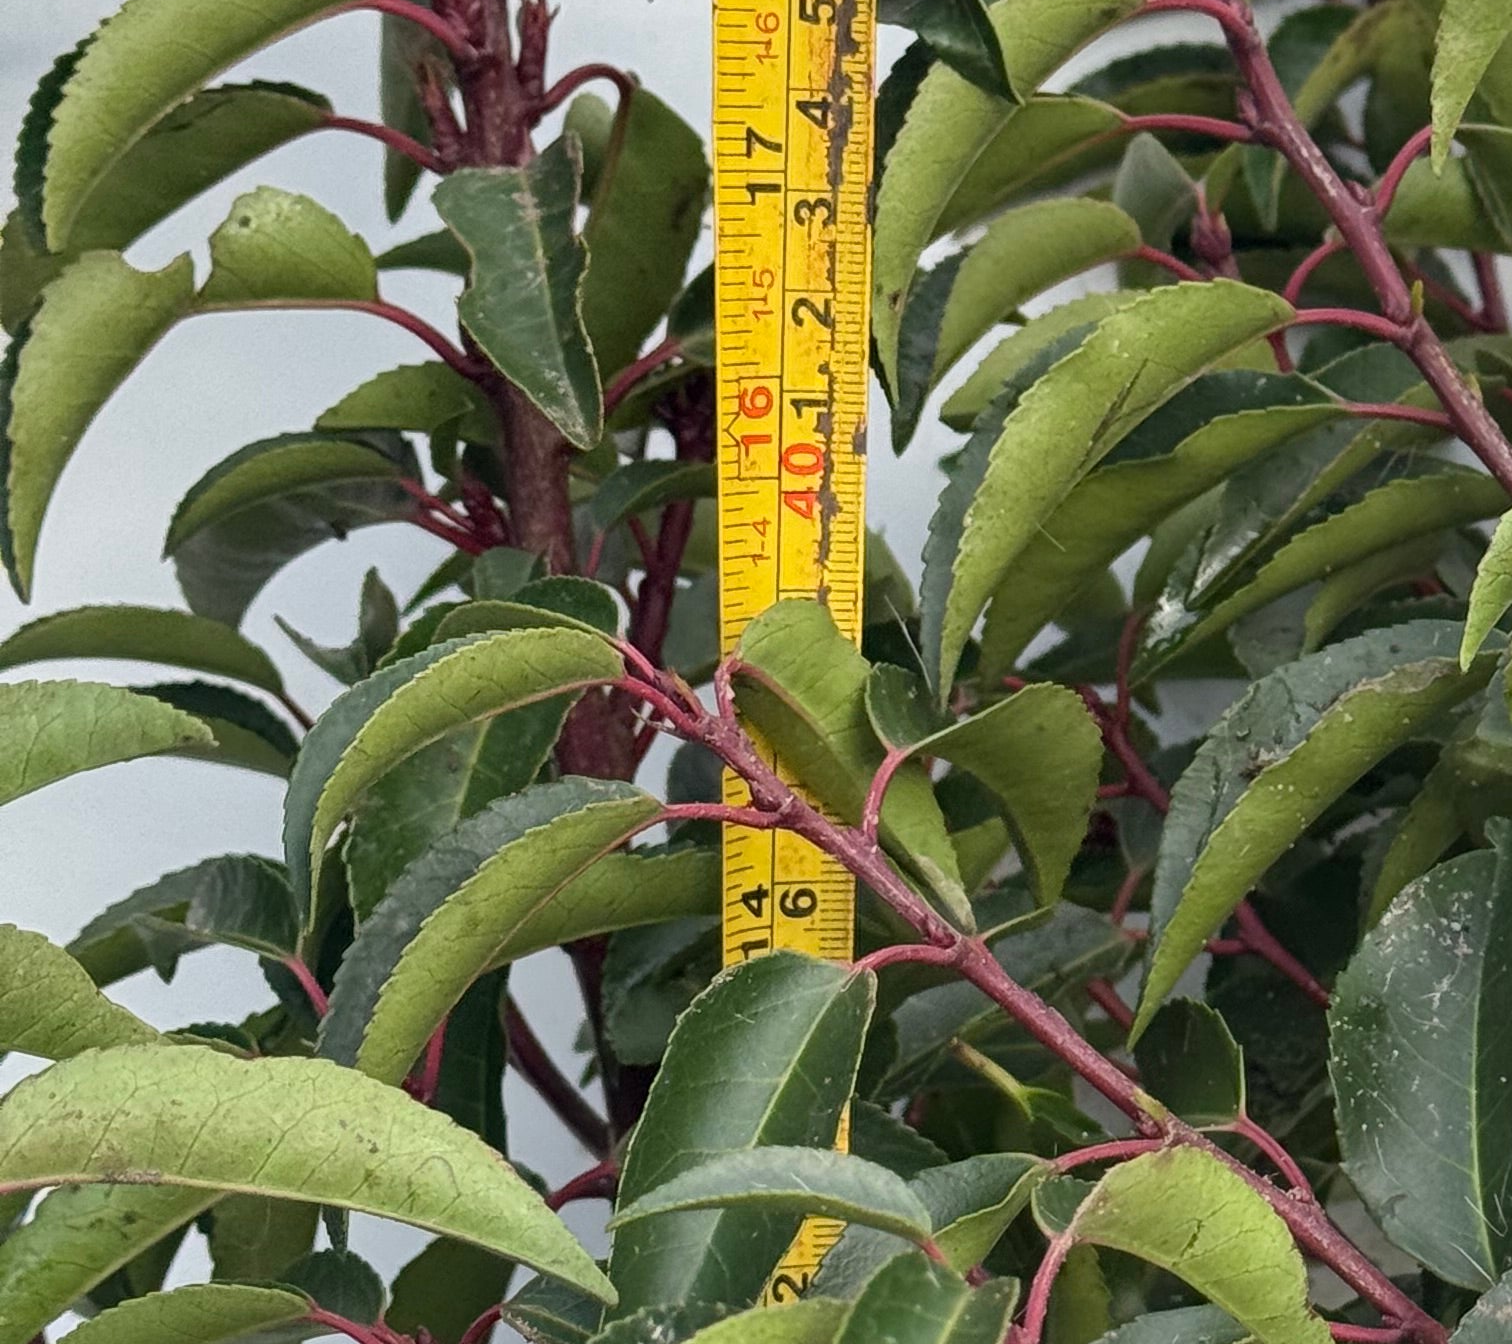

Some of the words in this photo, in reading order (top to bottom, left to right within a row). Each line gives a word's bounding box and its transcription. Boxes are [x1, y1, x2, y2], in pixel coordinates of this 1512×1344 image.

[795, 96, 833, 130] 4
[746, 127, 782, 206] 17
[793, 198, 832, 227] 3
[791, 297, 832, 329] 2
[739, 386, 773, 459] 16
[790, 398, 829, 419] 1
[782, 443, 824, 520] 40
[779, 887, 818, 919] 6
[741, 883, 769, 960] 14
[772, 1272, 809, 1303] 2
